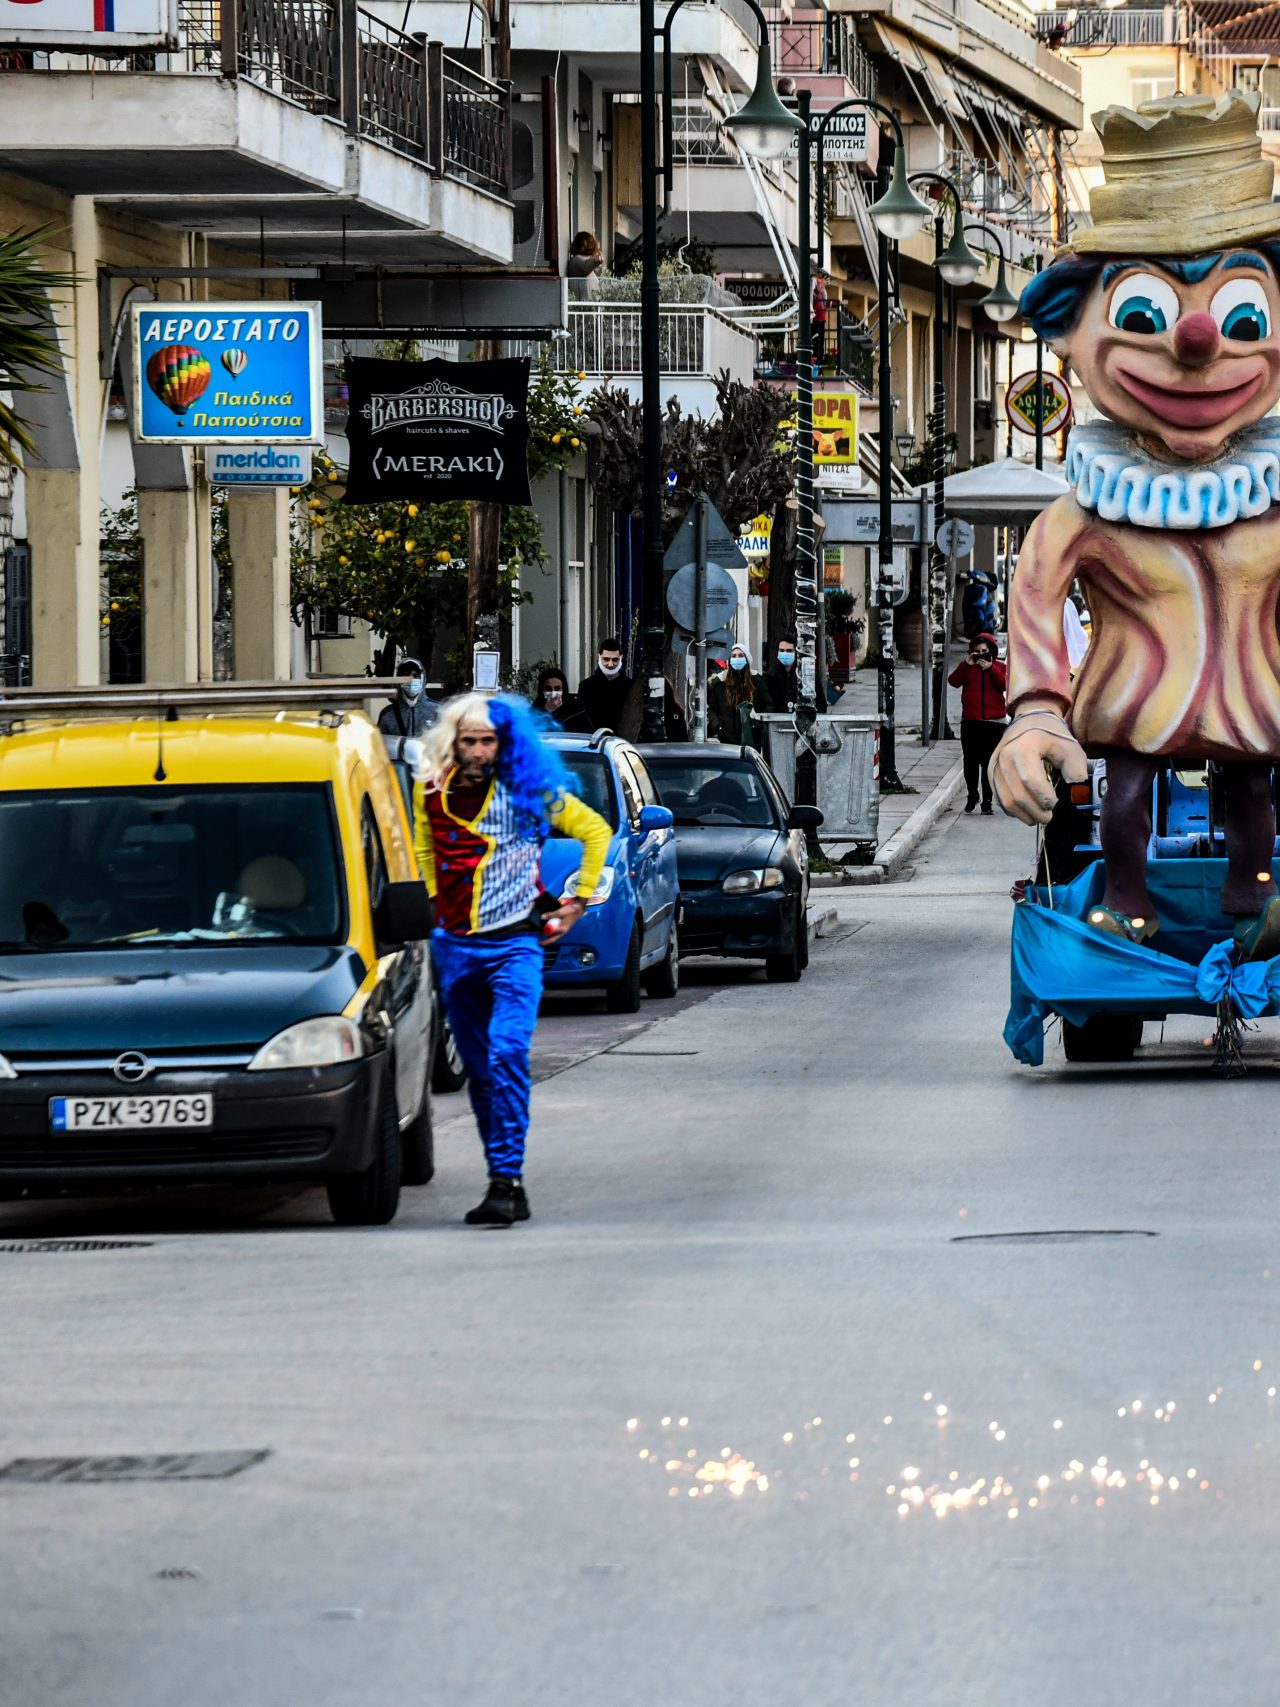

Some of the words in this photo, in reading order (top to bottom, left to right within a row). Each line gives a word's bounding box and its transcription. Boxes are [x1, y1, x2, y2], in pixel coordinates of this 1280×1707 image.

[144, 318, 300, 342] ΑΕΡΟΣΤΑΤΟ
[214, 391, 294, 406] Παιδικά
[813, 398, 852, 421] ΟΡΑ
[193, 413, 303, 428] Παπούτσια
[371, 396, 506, 431] BARBERSHOP
[216, 446, 300, 468] meridian
[217, 473, 300, 481] FOOTWEAR
